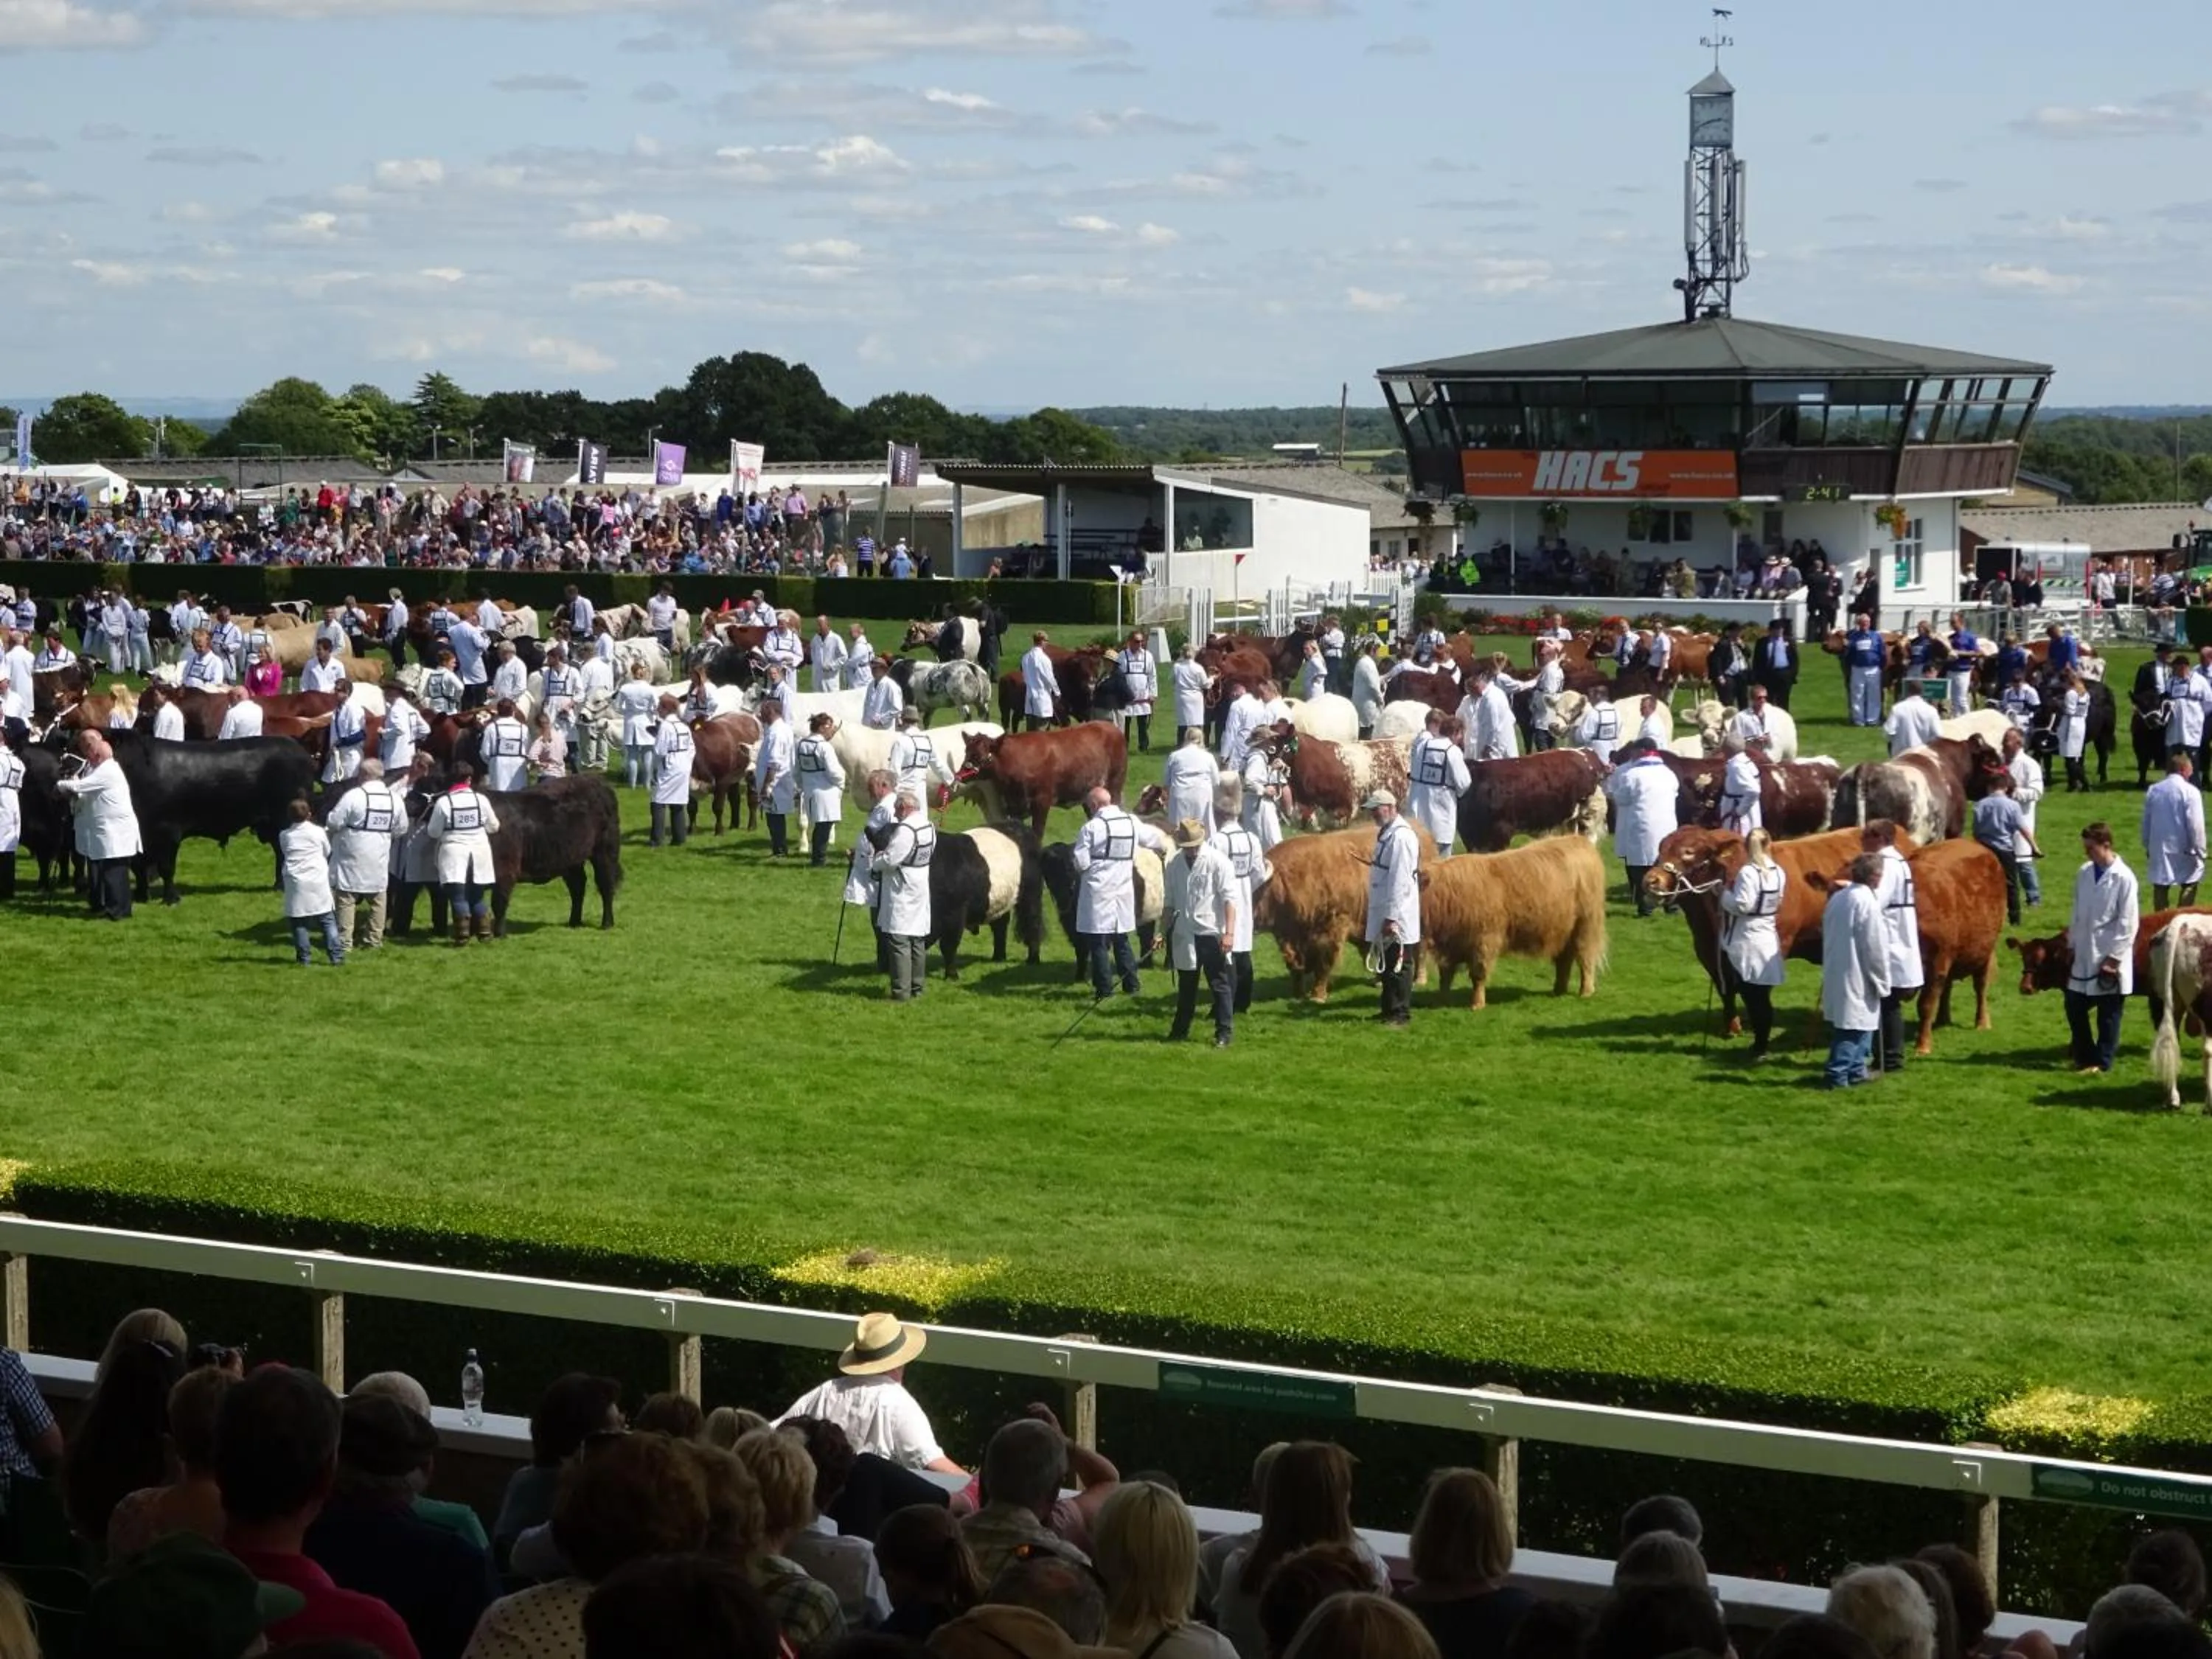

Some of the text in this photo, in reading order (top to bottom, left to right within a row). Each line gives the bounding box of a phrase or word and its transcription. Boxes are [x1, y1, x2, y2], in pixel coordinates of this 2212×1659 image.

[1533, 451, 1644, 490] HACS
[2101, 1481, 2120, 1495] Do
[2124, 1486, 2146, 1498] not
[2149, 1487, 2207, 1504] obstruct
